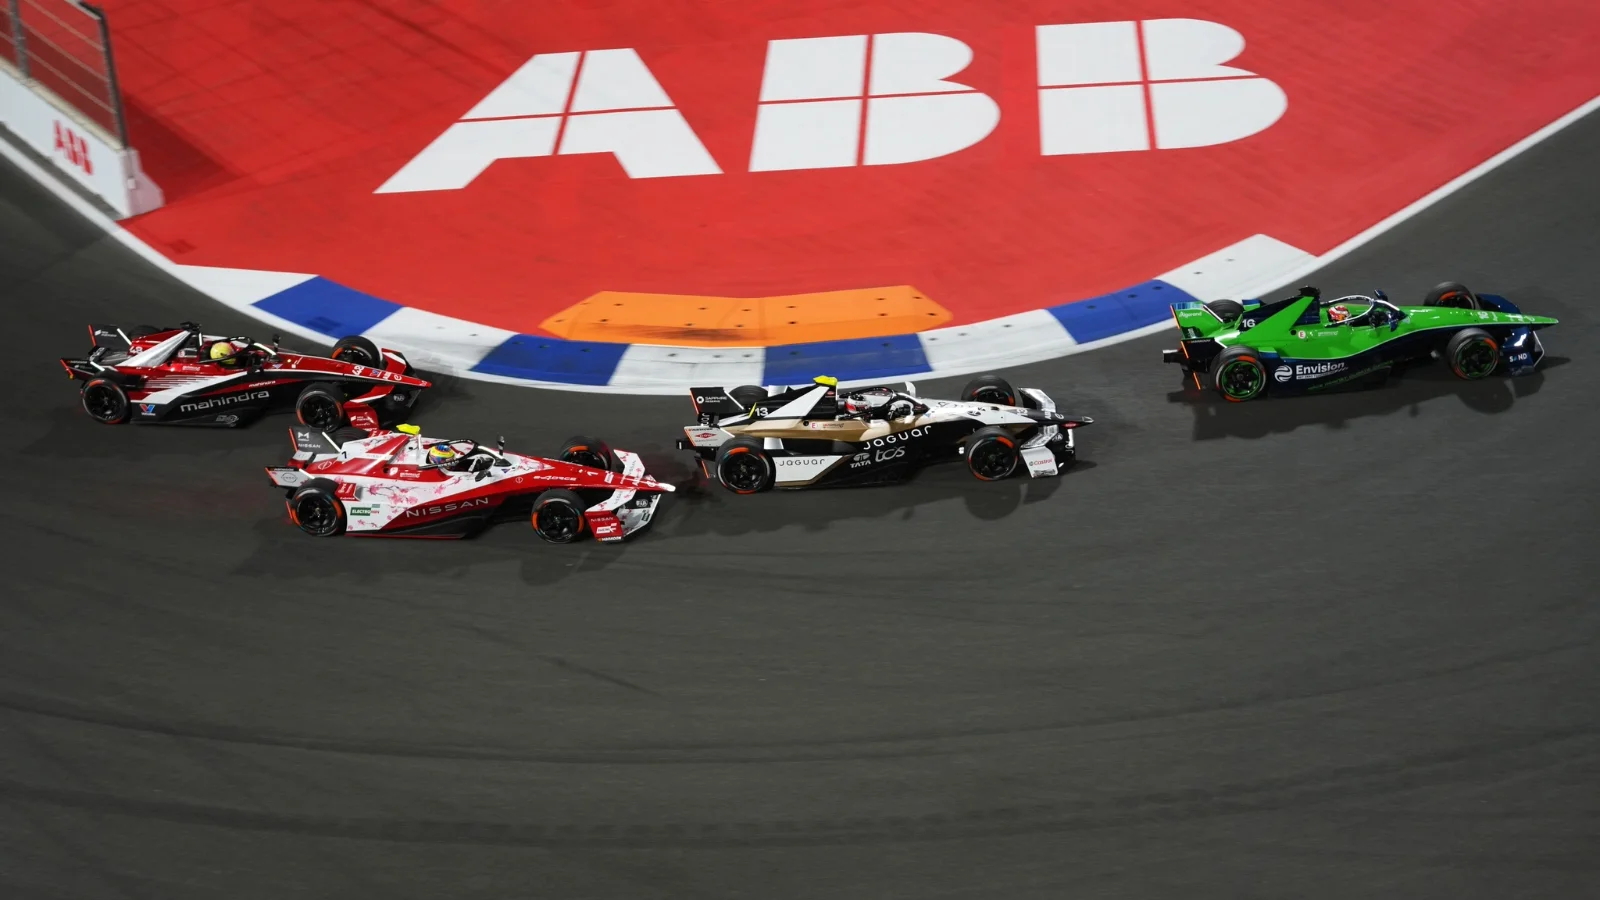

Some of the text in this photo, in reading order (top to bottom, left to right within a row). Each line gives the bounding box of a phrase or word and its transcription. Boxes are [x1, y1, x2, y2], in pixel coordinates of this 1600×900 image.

[372, 18, 1288, 193] ABB
[54, 120, 92, 175] ABB
[1242, 319, 1256, 328] 16
[129, 346, 144, 354] 48
[1296, 362, 1345, 375] Envision
[180, 390, 270, 412] mahindra
[755, 407, 769, 417] 13
[341, 451, 348, 459] 1
[850, 460, 872, 469] TATA
[405, 497, 489, 518] NISSAN
